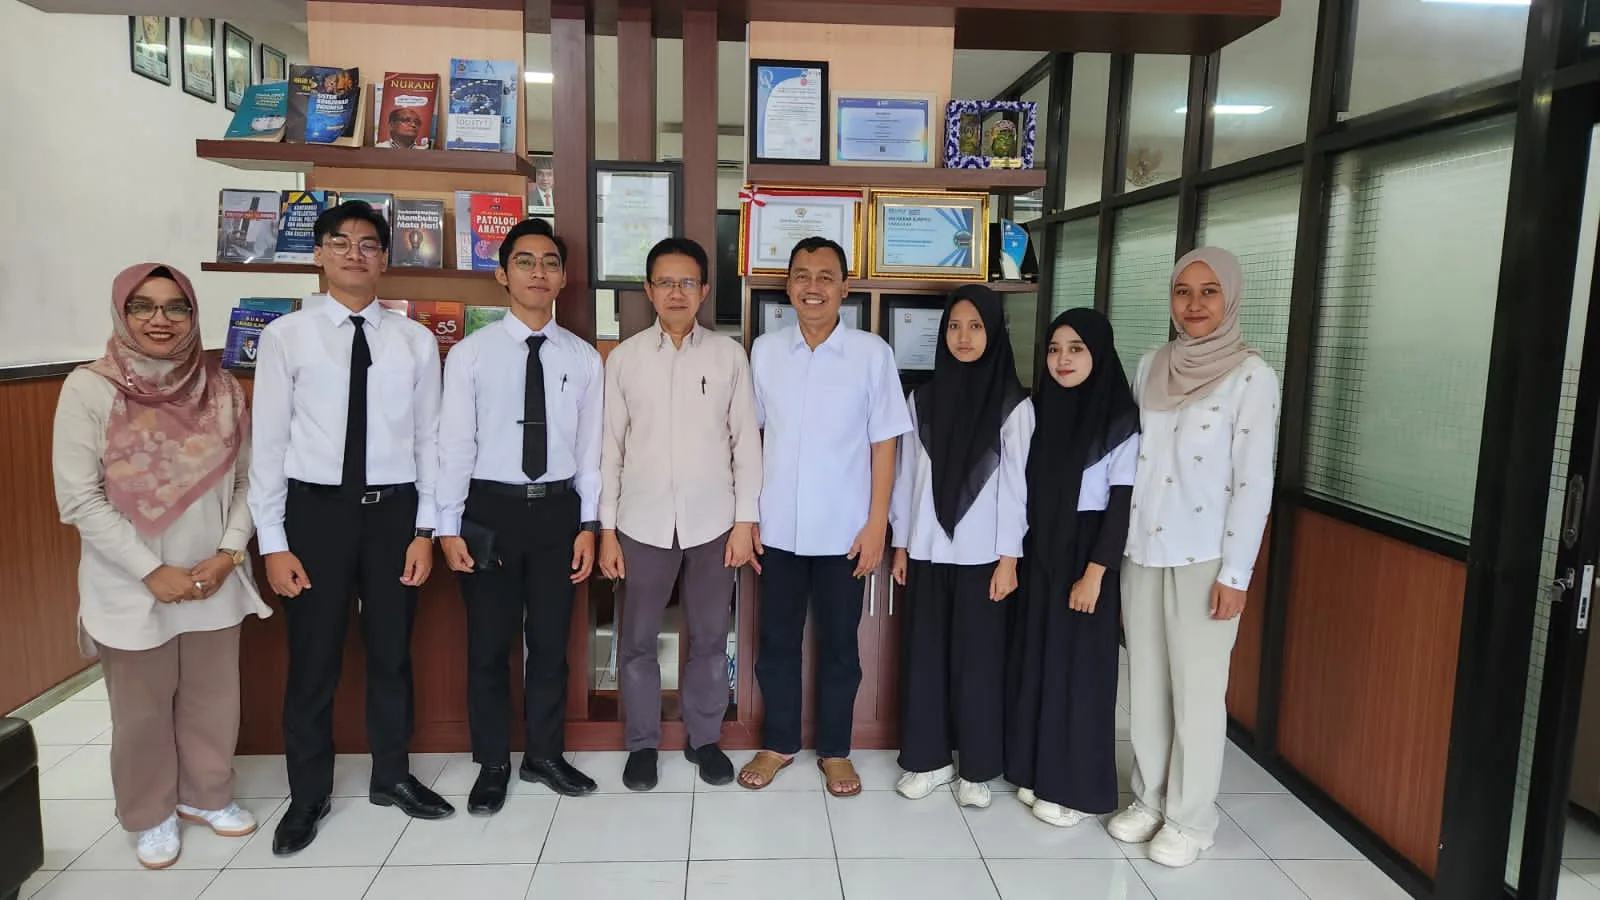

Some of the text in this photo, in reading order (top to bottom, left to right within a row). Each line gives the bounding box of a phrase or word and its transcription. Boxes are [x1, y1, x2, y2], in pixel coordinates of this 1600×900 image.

[391, 79, 434, 89] NURANI
[397, 214, 439, 222] Membuka
[476, 215, 518, 226] PATOLOGI
[397, 221, 439, 230] Mata Hati
[478, 225, 513, 234] ANATOM
[435, 320, 457, 335] 55
